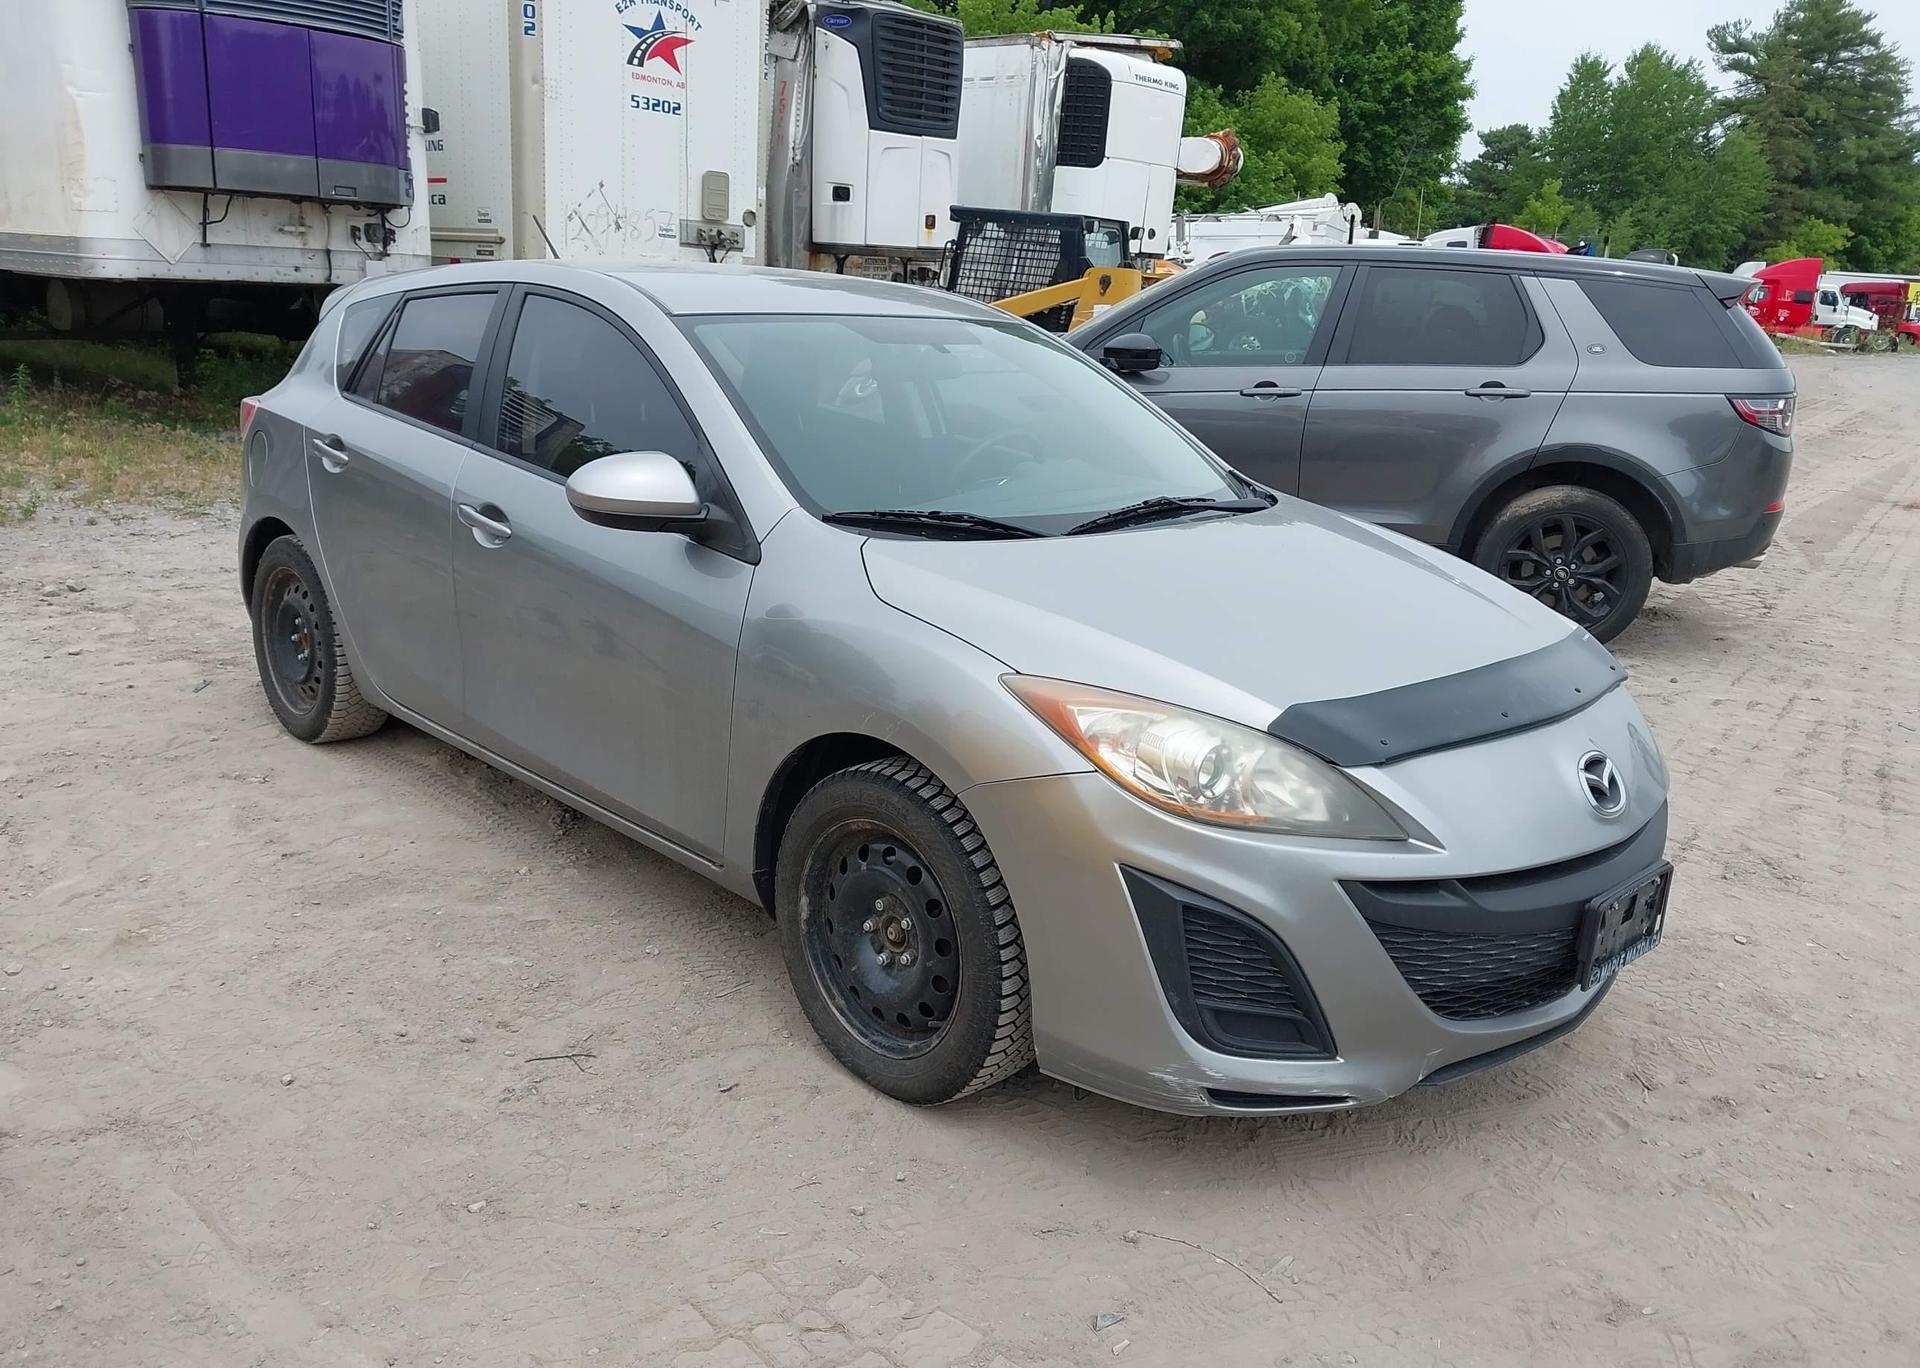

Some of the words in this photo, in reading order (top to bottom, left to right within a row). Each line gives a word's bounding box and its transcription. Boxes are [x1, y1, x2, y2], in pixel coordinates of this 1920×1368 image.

[523, 0, 536, 36] 02
[632, 72, 674, 88] EDMONTON,
[676, 81, 685, 89] AB
[1134, 73, 1163, 86] THERMO
[1164, 80, 1180, 91] KING
[631, 94, 681, 116] 53202
[425, 139, 444, 152] ING
